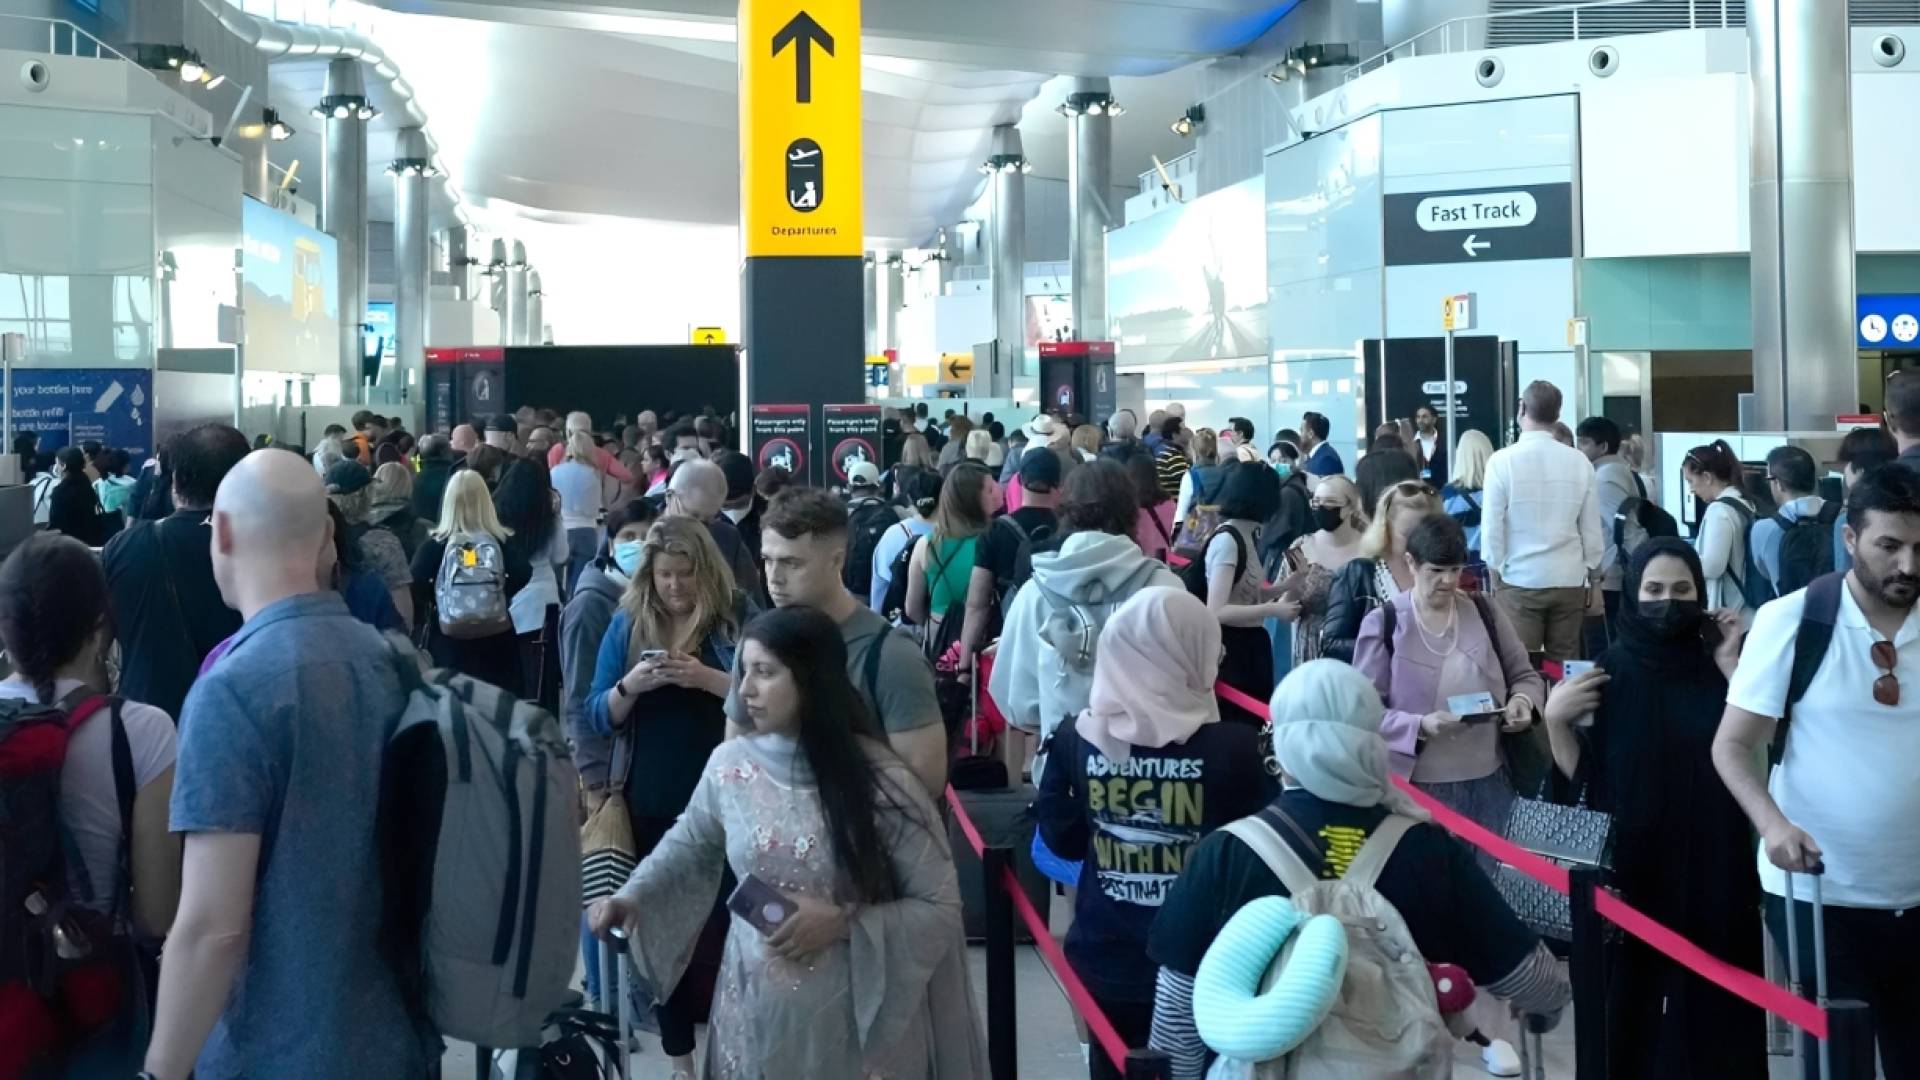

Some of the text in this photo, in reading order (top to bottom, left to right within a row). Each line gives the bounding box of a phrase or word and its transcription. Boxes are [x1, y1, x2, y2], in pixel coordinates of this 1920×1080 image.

[1431, 200, 1521, 222] Fast Track
[772, 226, 836, 236] Departures
[13, 385, 35, 398] your
[37, 384, 70, 395] bottles
[1087, 754, 1204, 778] ADVENTURES
[1088, 777, 1204, 827] BEGIN
[1093, 832, 1184, 874] WITH N
